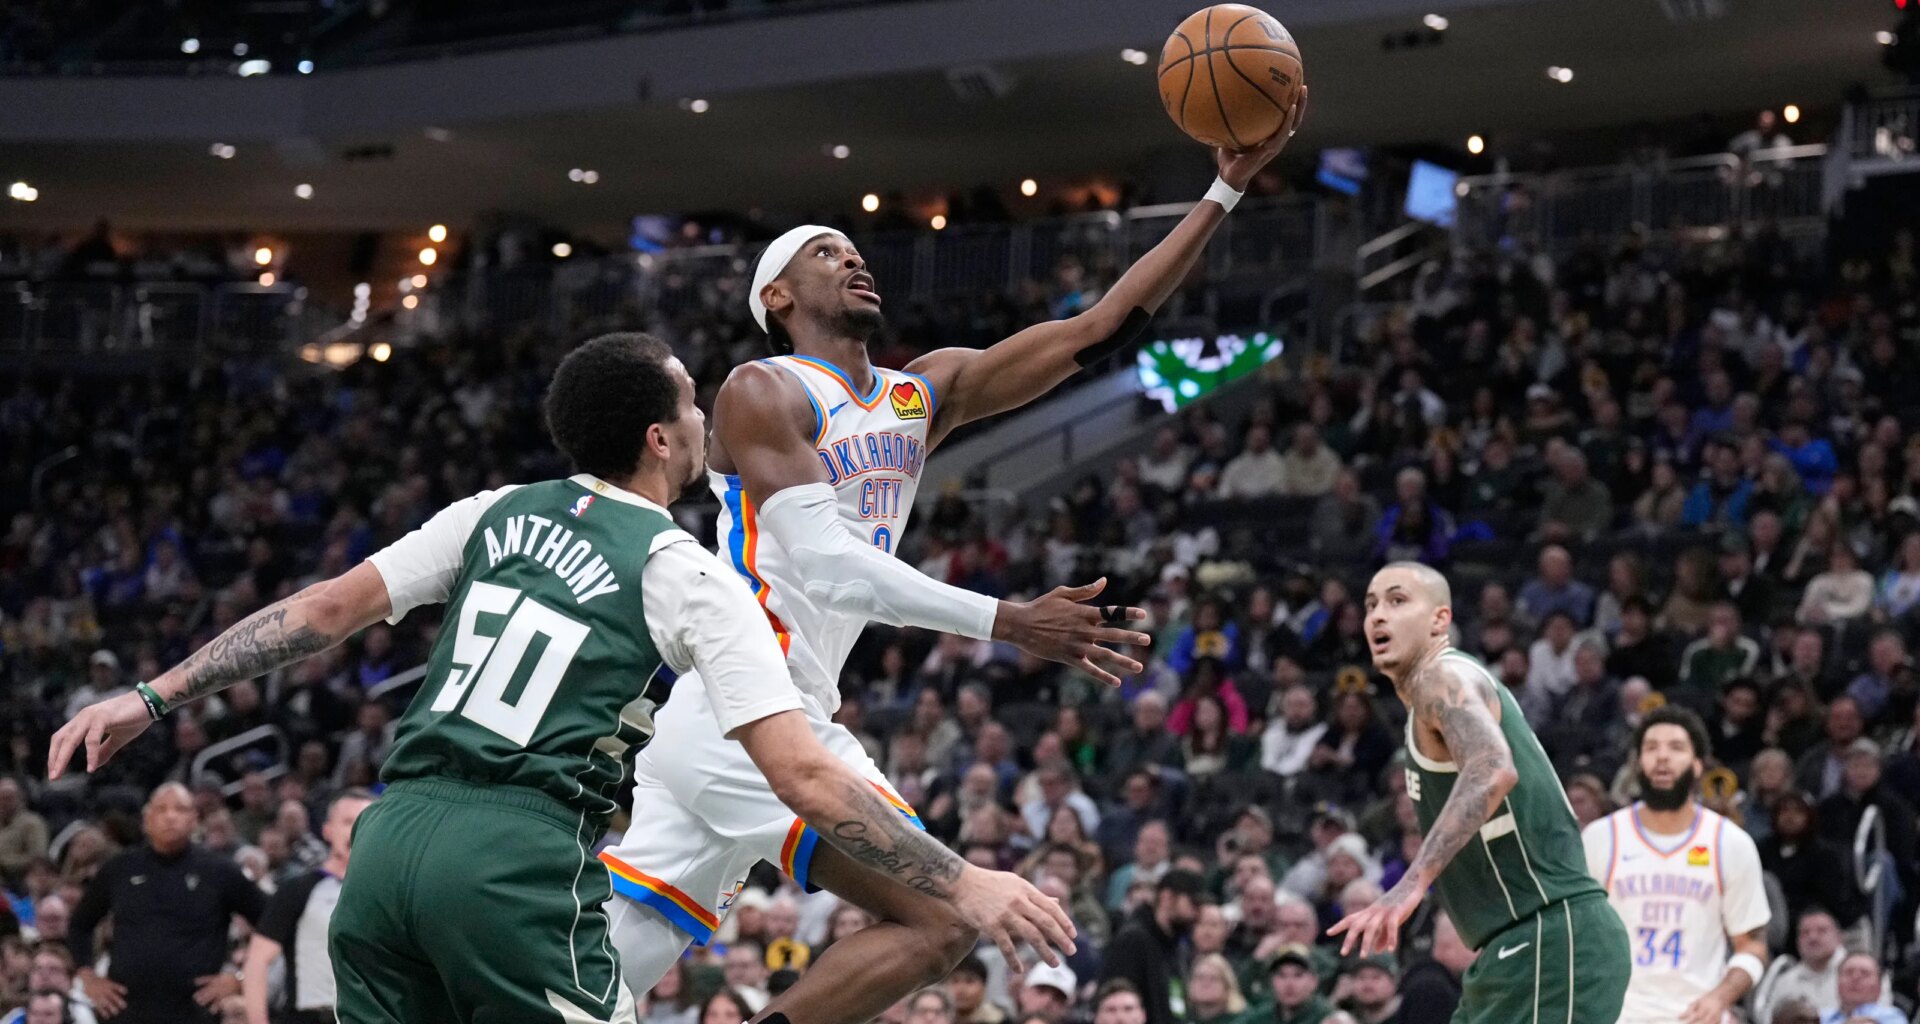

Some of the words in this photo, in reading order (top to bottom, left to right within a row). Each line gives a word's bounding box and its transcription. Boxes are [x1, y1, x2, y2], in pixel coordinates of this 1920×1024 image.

[816, 432, 925, 486] OKLAHOMA
[859, 478, 902, 518] CITY
[484, 514, 620, 605] ANTHONY
[209, 608, 288, 662] Gregory
[430, 580, 592, 748] 50
[833, 821, 914, 874] Crystal
[1615, 873, 1715, 906] OKLAHOMA
[1641, 901, 1684, 923] CITY
[1635, 926, 1685, 969] 34
